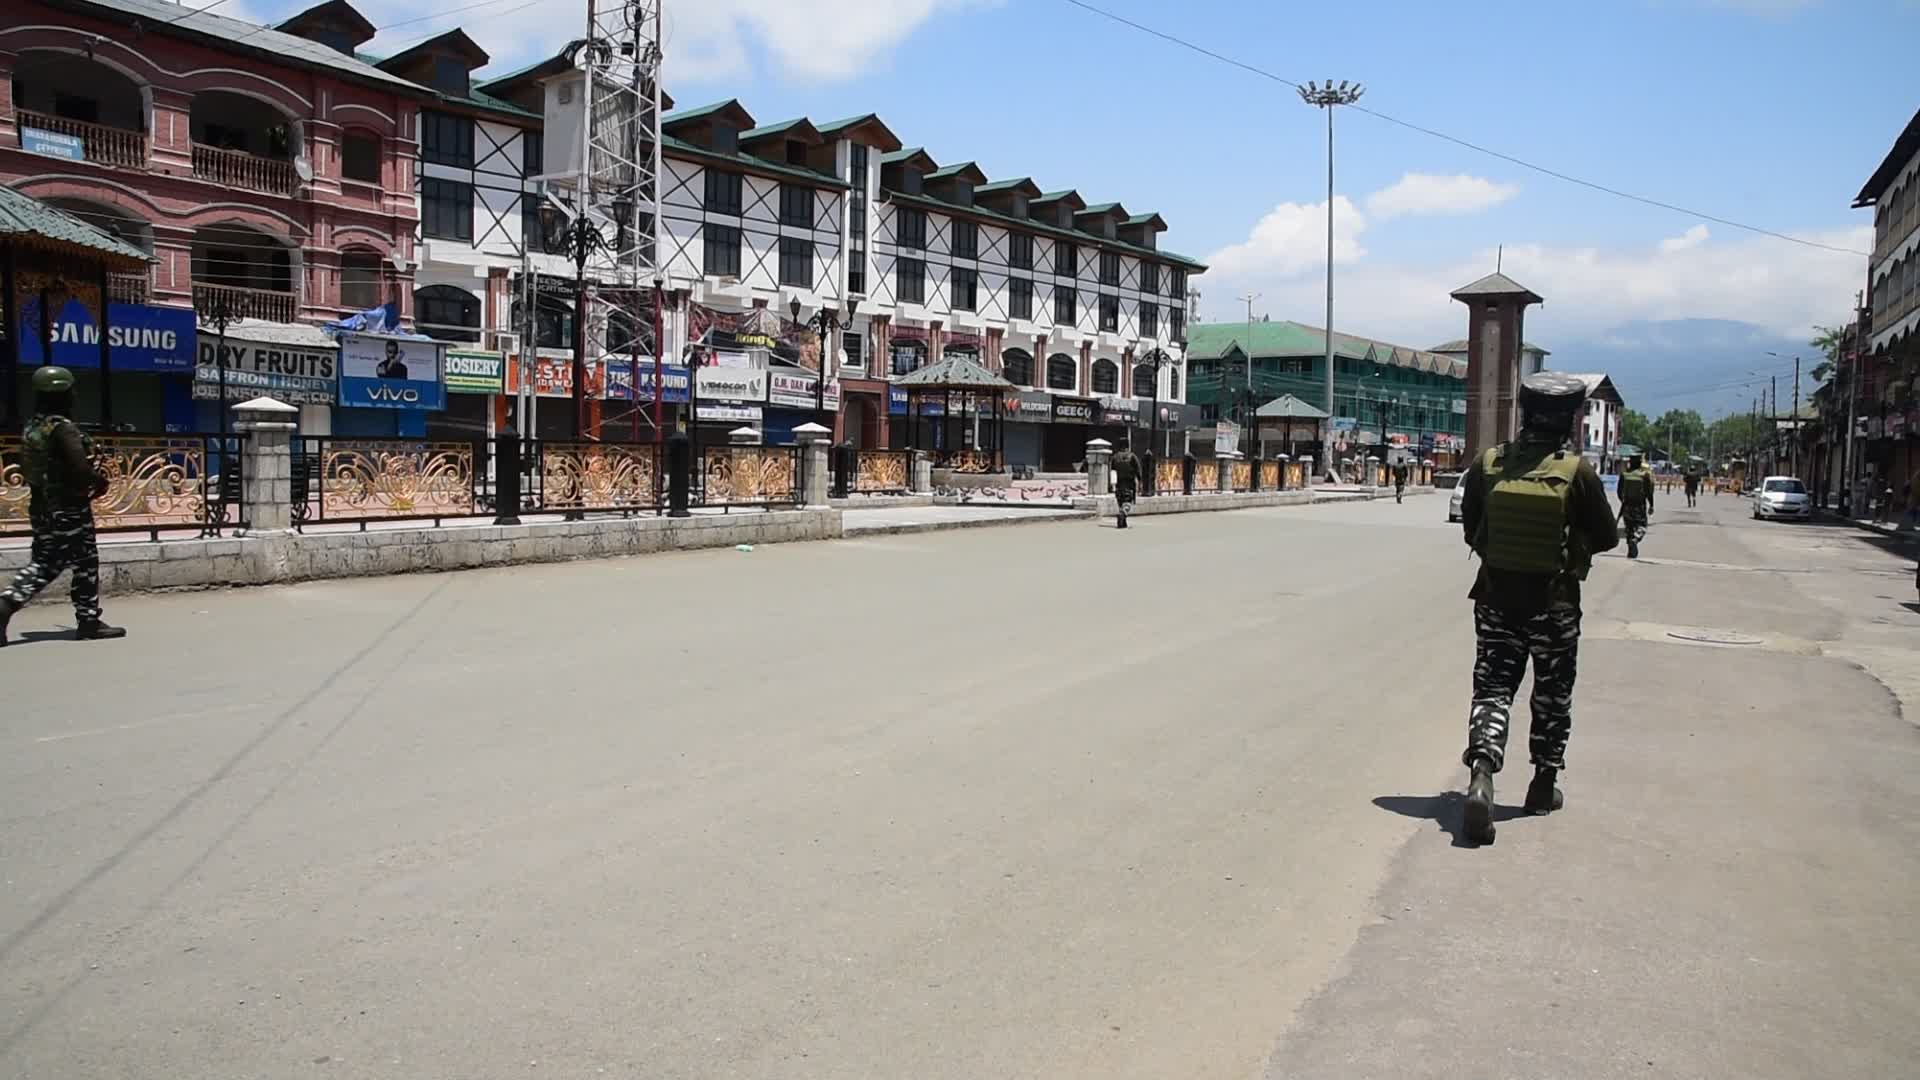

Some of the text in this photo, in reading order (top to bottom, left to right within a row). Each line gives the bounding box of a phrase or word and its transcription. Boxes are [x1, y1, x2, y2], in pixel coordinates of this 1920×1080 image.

[200, 343, 333, 378] DRY FRUITS
[281, 377, 328, 390] HONEY
